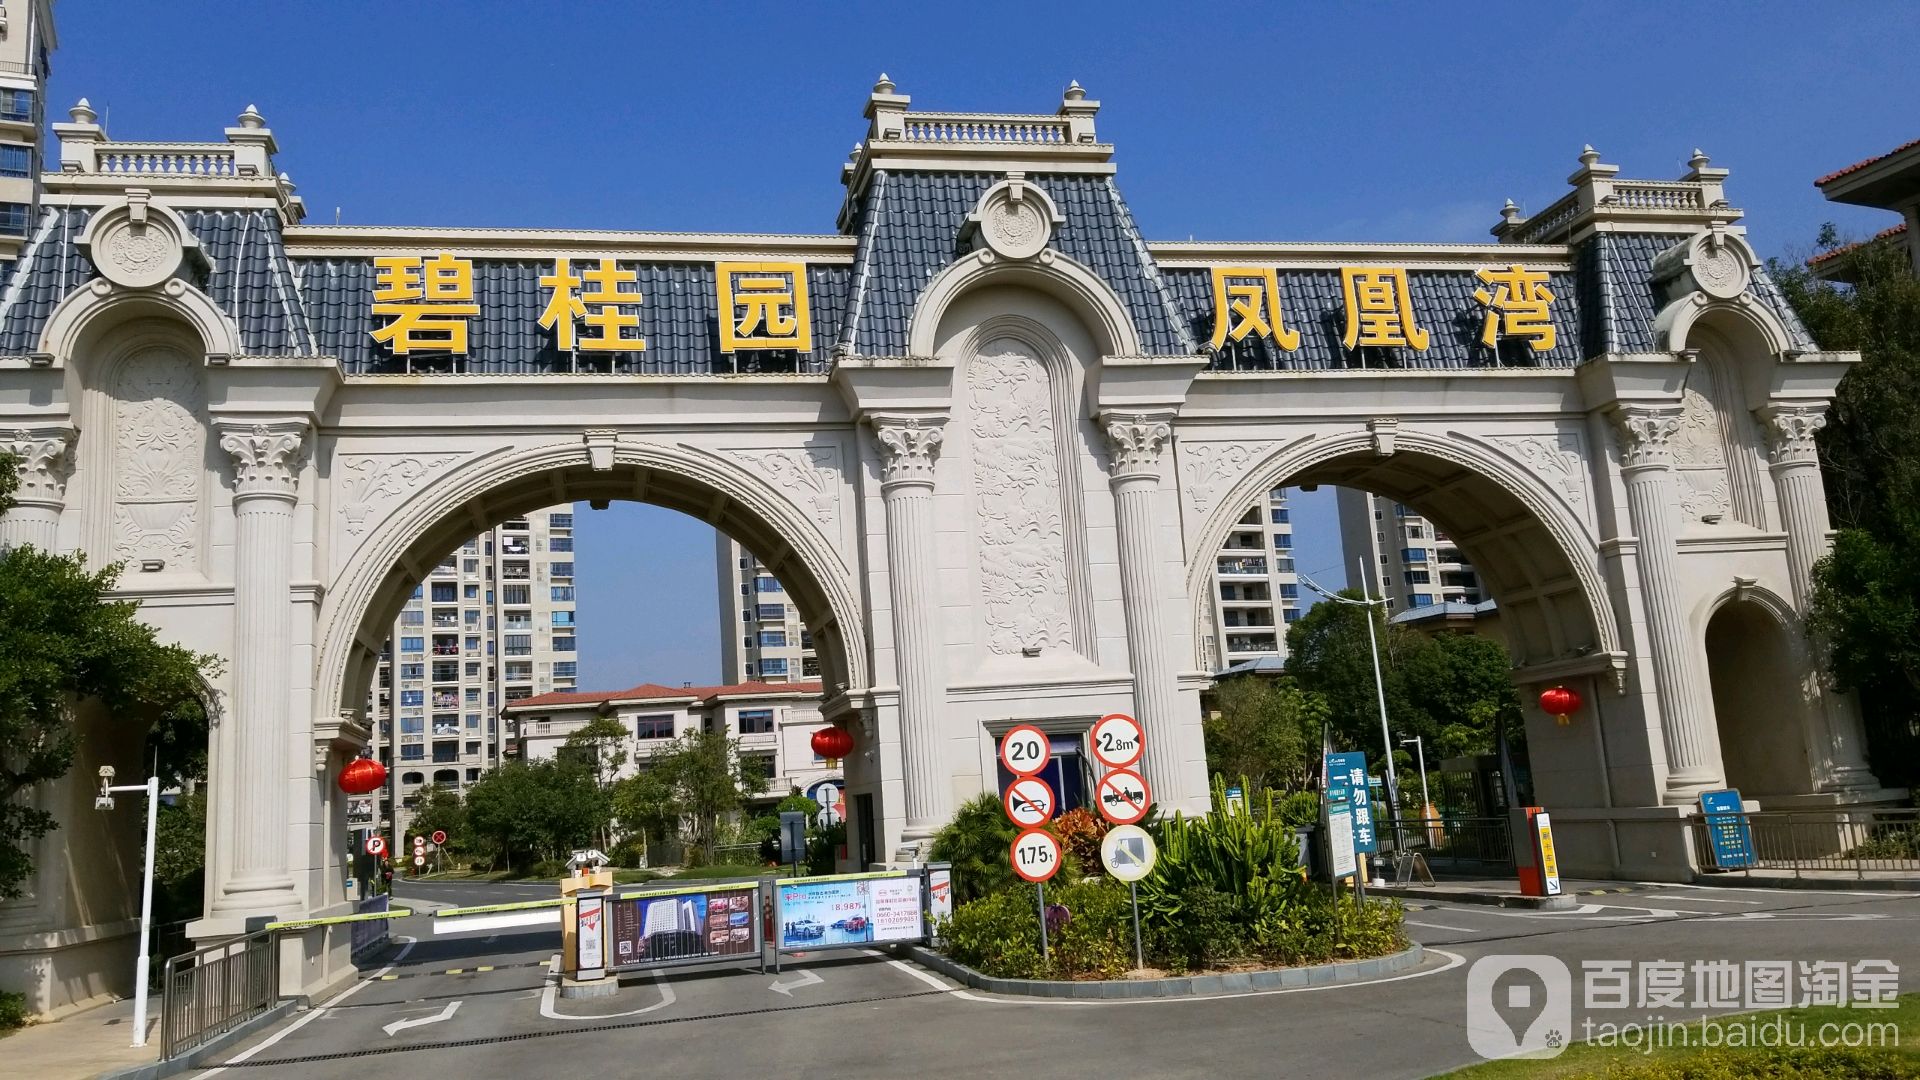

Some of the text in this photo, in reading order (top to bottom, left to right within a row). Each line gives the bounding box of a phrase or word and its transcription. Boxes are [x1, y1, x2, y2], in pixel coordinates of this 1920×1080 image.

[369, 254, 812, 354] 碧桂园
[1211, 264, 1557, 351] 凤凰湾
[1011, 740, 1040, 761] 20
[1102, 732, 1134, 752] 2.8m
[1349, 767, 1372, 846] 请勿跟车
